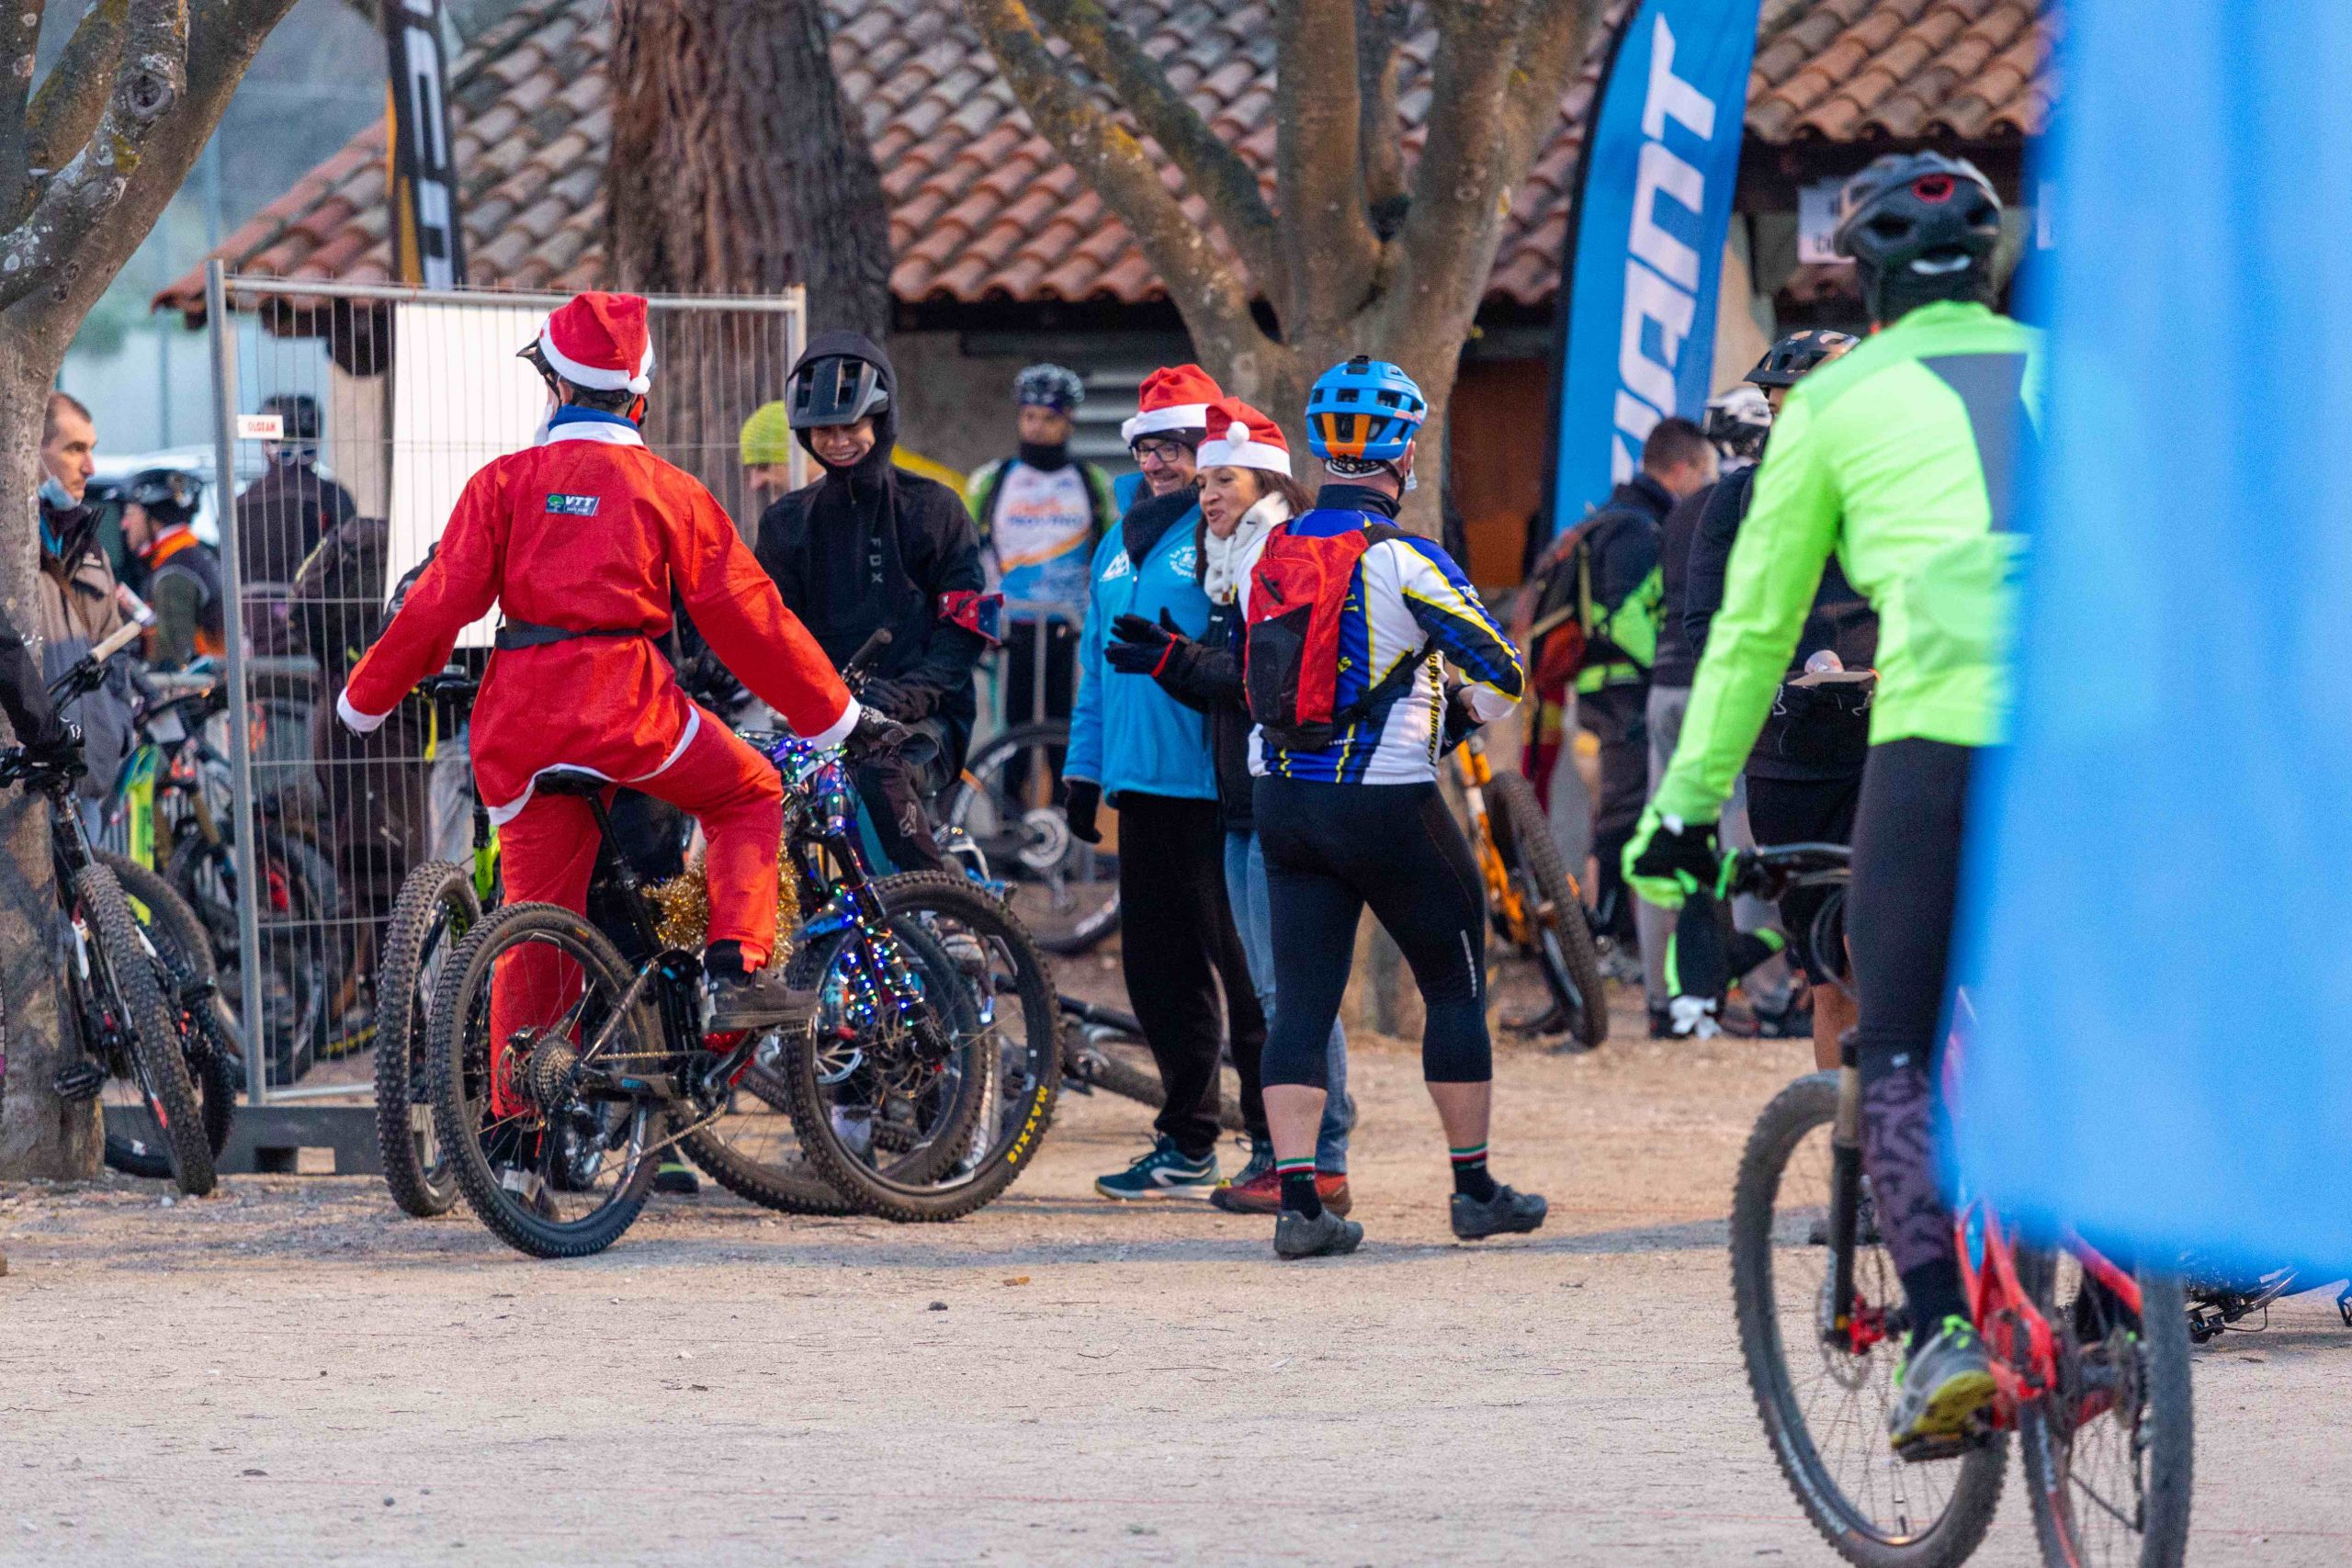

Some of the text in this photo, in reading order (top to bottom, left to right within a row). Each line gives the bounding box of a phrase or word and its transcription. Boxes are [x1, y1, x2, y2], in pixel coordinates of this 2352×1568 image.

[565, 495, 595, 507] VTT
[869, 537, 883, 583] FOX
[1007, 1085, 1048, 1164] MAXXIS
